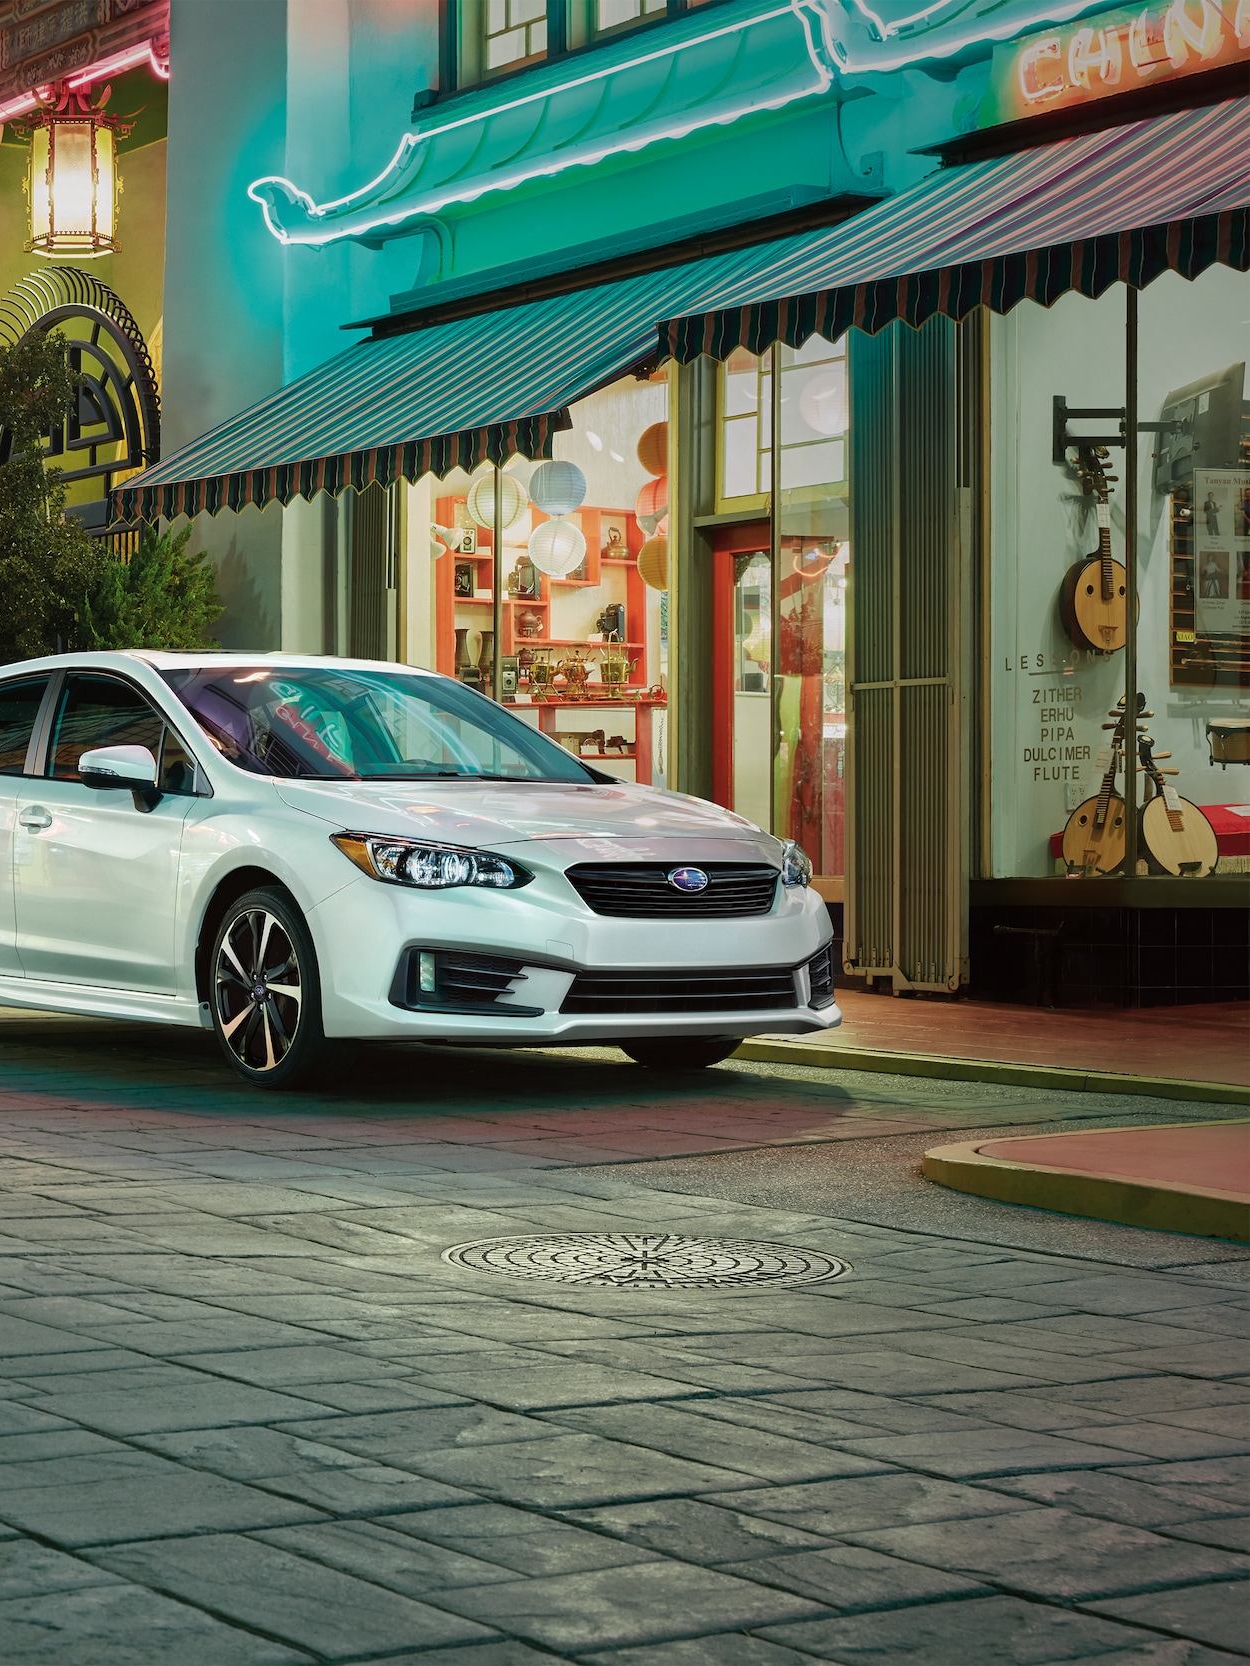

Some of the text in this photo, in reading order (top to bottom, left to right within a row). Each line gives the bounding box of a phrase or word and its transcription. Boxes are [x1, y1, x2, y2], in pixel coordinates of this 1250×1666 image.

[1204, 477, 1231, 486] Tanyan
[1005, 649, 1111, 672] LESSONS
[1032, 687, 1082, 704] ZITHER
[1040, 707, 1074, 722] ERHU
[1040, 727, 1074, 742] PIPA
[1023, 745, 1091, 762] DULCIMER
[1034, 765, 1080, 781] FLUTE
